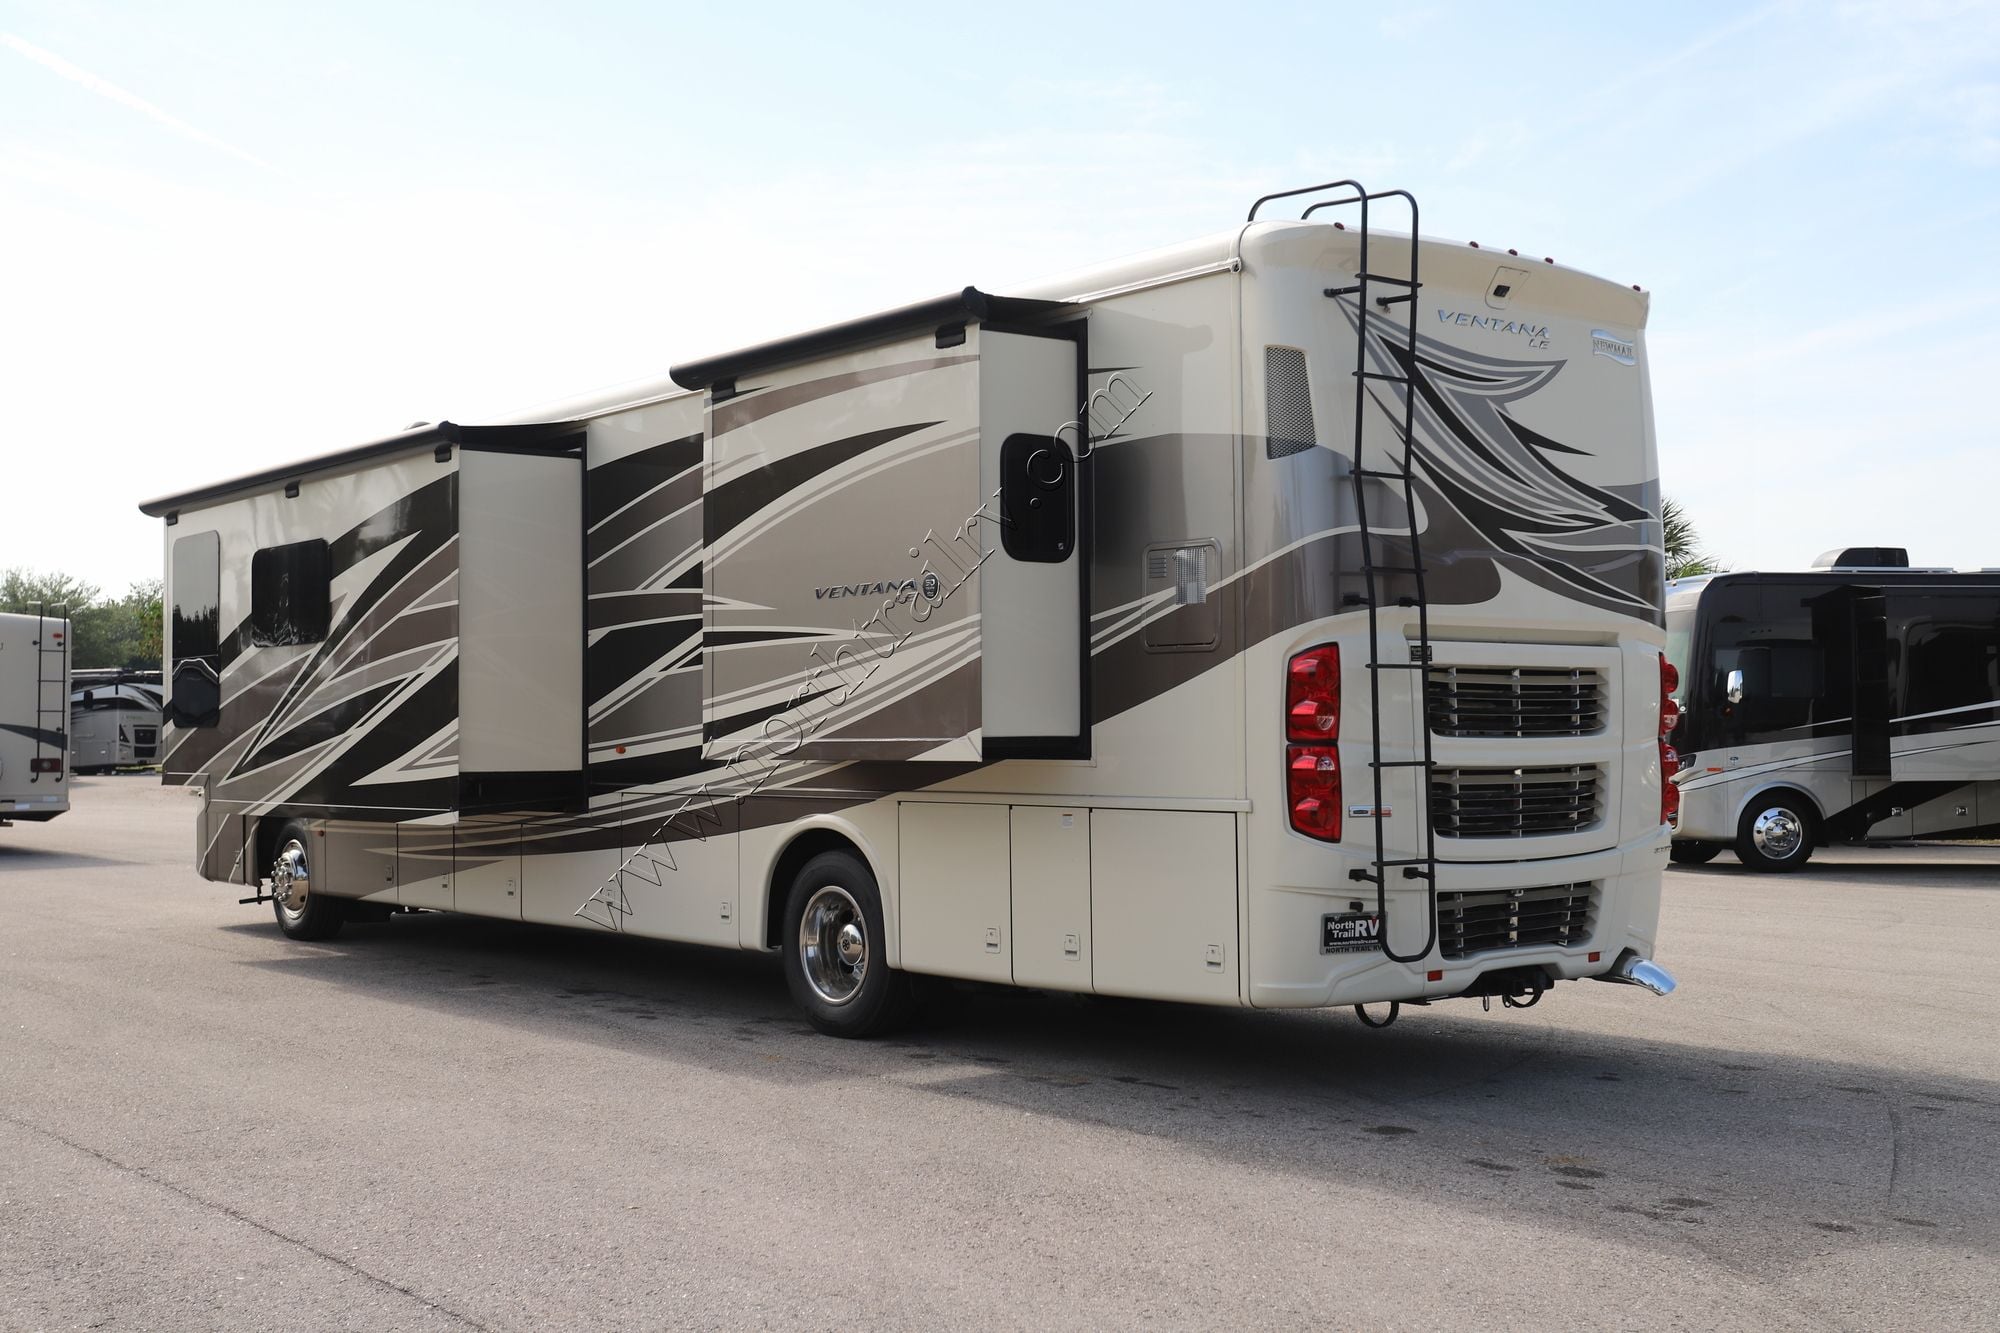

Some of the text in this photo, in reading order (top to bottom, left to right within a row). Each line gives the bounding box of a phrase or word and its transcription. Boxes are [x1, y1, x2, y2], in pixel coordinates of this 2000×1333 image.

[1437, 309, 1551, 339] VENTANA
[1529, 338, 1551, 350] LE
[815, 578, 918, 600] VENTANA
[1327, 921, 1354, 930] North
[1355, 919, 1380, 937] RV
[1332, 930, 1354, 938] Trail
